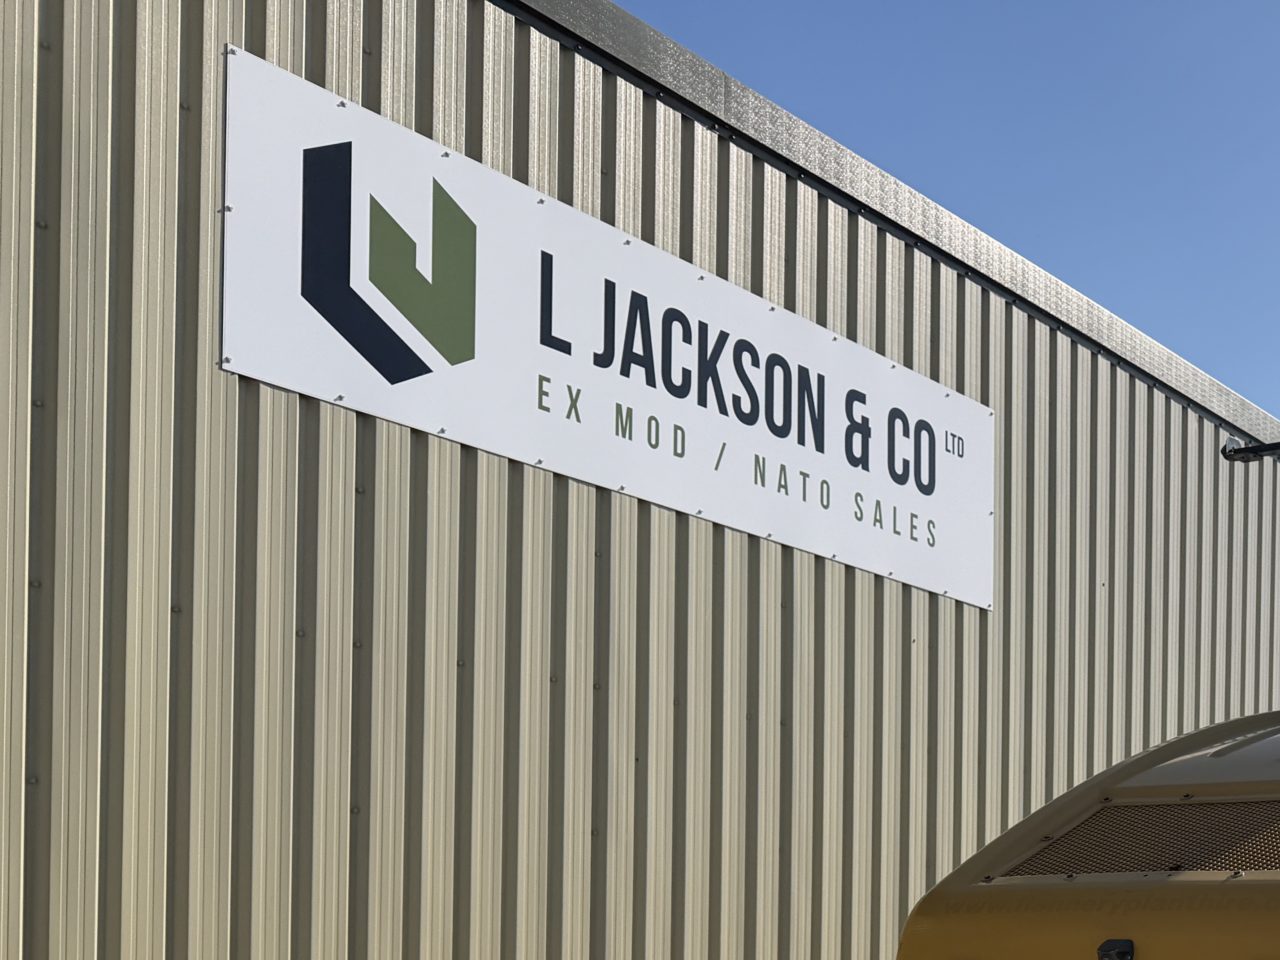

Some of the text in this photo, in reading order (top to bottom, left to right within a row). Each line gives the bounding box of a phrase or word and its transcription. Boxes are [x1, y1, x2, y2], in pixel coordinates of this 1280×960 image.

[537, 374, 938, 548] EX MOD / NATO SALES
[540, 250, 965, 497] L JACKSON & CO LTD
